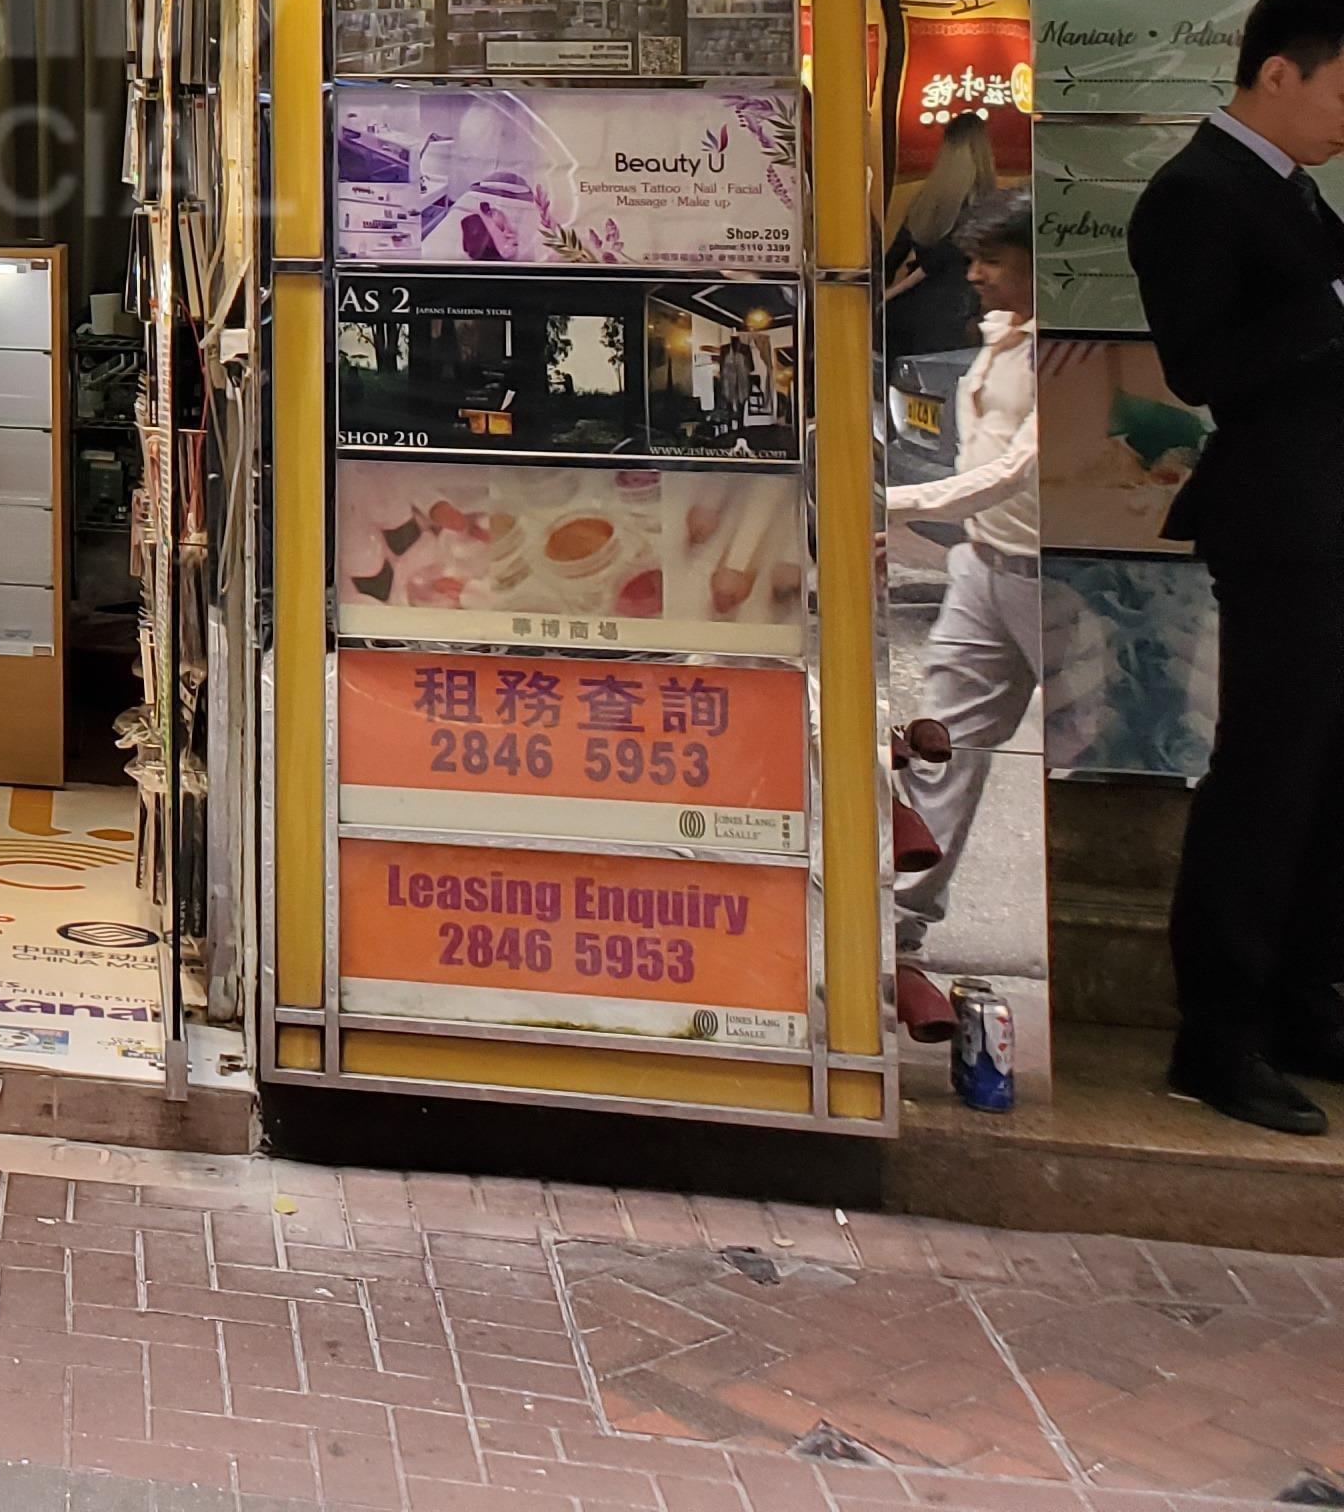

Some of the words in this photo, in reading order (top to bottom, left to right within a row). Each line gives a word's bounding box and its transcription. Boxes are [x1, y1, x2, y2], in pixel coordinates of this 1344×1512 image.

[616, 153, 701, 177] Beauty
[708, 154, 724, 173] U
[580, 182, 637, 195] Eyebrows
[642, 182, 681, 194] Tattoo
[693, 182, 717, 194] Nail
[728, 183, 762, 194] Facial
[616, 196, 667, 208] Massage
[677, 196, 710, 207] Make
[714, 199, 731, 209] up
[392, 287, 411, 313] 2
[338, 431, 388, 445] SHOP
[394, 432, 428, 447] 210
[414, 667, 730, 738] 租務查詢
[431, 728, 553, 778] 2846
[584, 737, 710, 788] 5953
[388, 865, 562, 922] Leasing
[574, 876, 749, 936] Enquiry
[11, 953, 99, 966] CHINA
[439, 922, 552, 973] 2846
[575, 932, 695, 984] 5953
